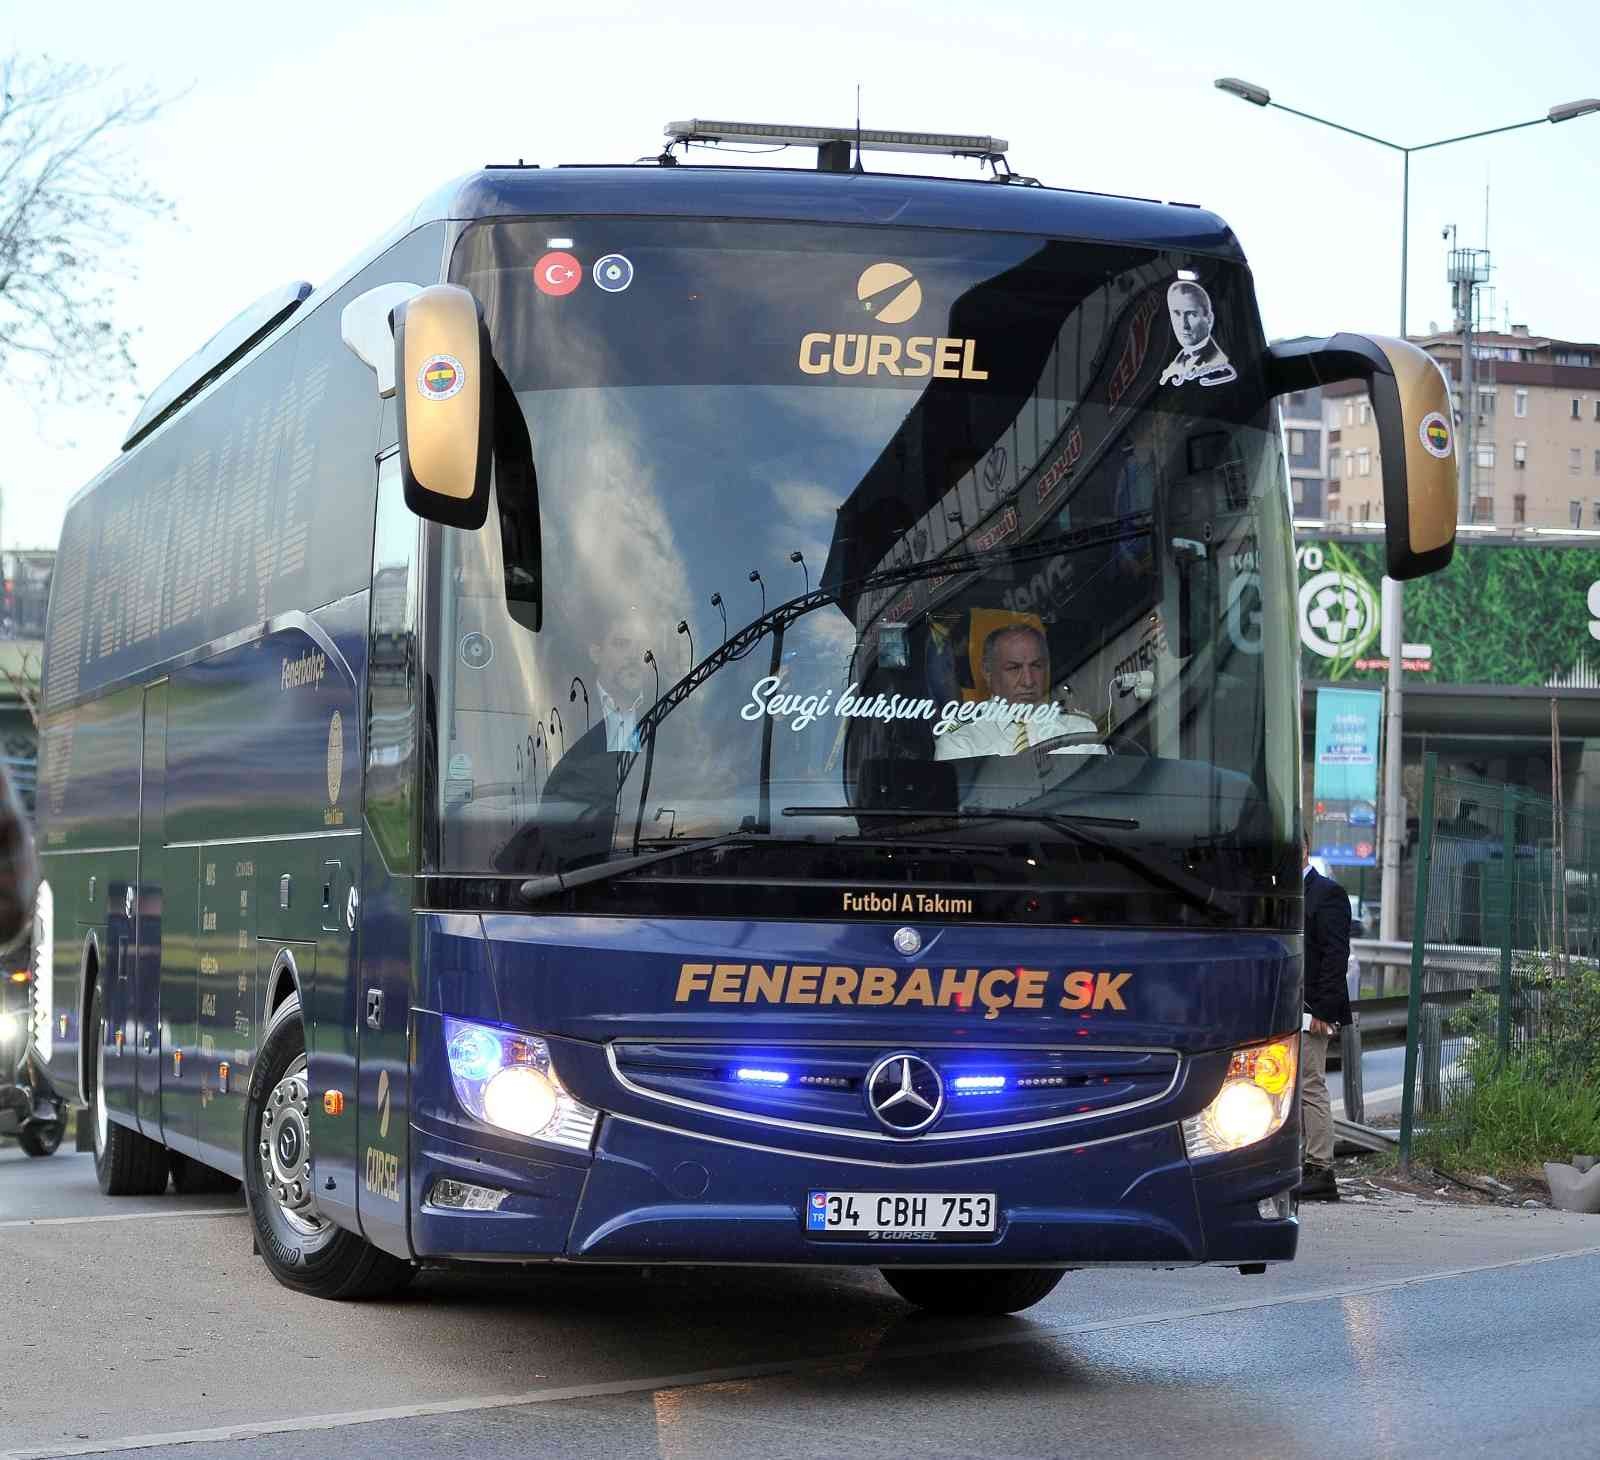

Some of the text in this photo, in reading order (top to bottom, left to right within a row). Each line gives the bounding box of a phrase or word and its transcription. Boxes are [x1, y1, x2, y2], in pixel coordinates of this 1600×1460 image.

[798, 332, 989, 380] GÜRSEL
[281, 651, 325, 691] Fenerbahçe
[741, 676, 829, 732] Sevgi
[834, 681, 935, 723] kurşun
[842, 893, 973, 914] Futbol A Takımı
[675, 963, 1133, 1021] FENERBAHÇE SK
[812, 1212, 825, 1223] TR
[827, 1196, 990, 1227] 34 CBH 753
